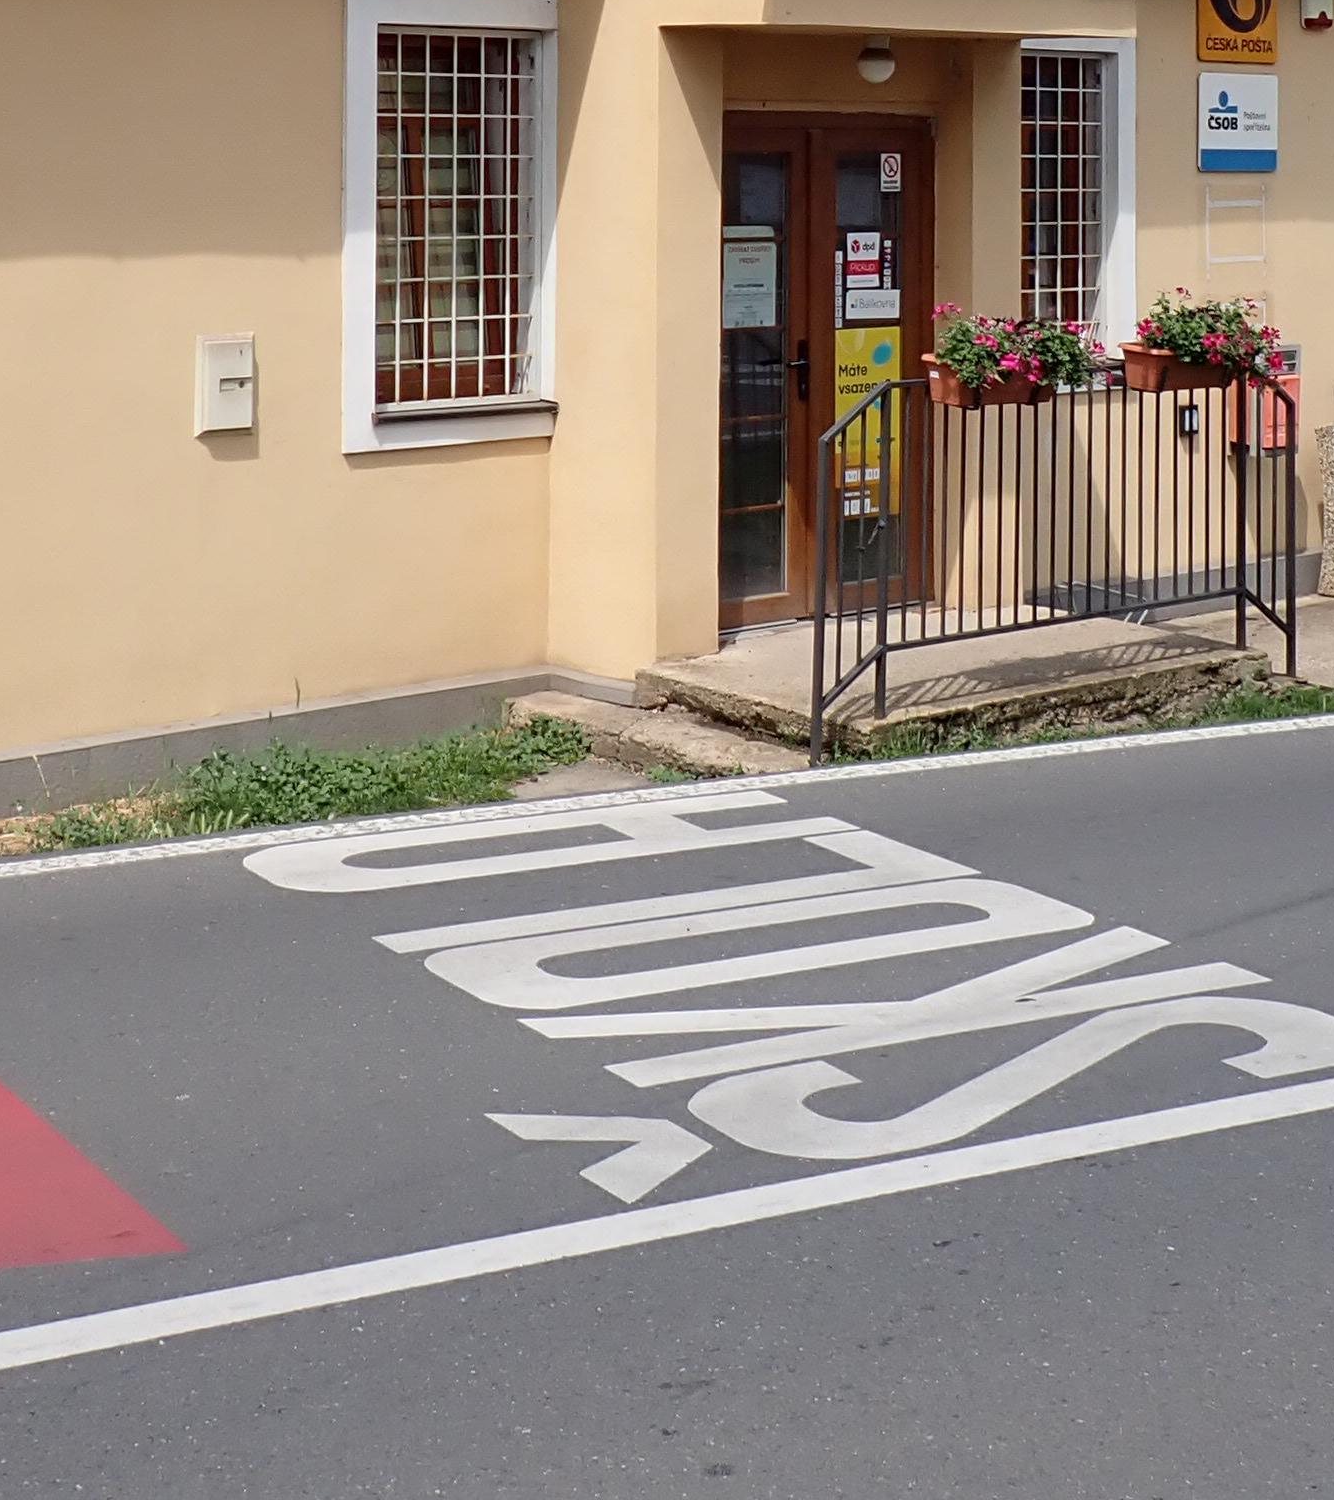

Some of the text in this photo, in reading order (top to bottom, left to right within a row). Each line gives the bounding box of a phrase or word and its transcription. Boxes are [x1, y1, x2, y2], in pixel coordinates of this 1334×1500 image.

[1205, 34, 1274, 53] ČESKÁ POŠTA
[1207, 114, 1239, 130] ČSOB
[862, 242, 876, 252] dpd
[838, 362, 868, 377] Máte
